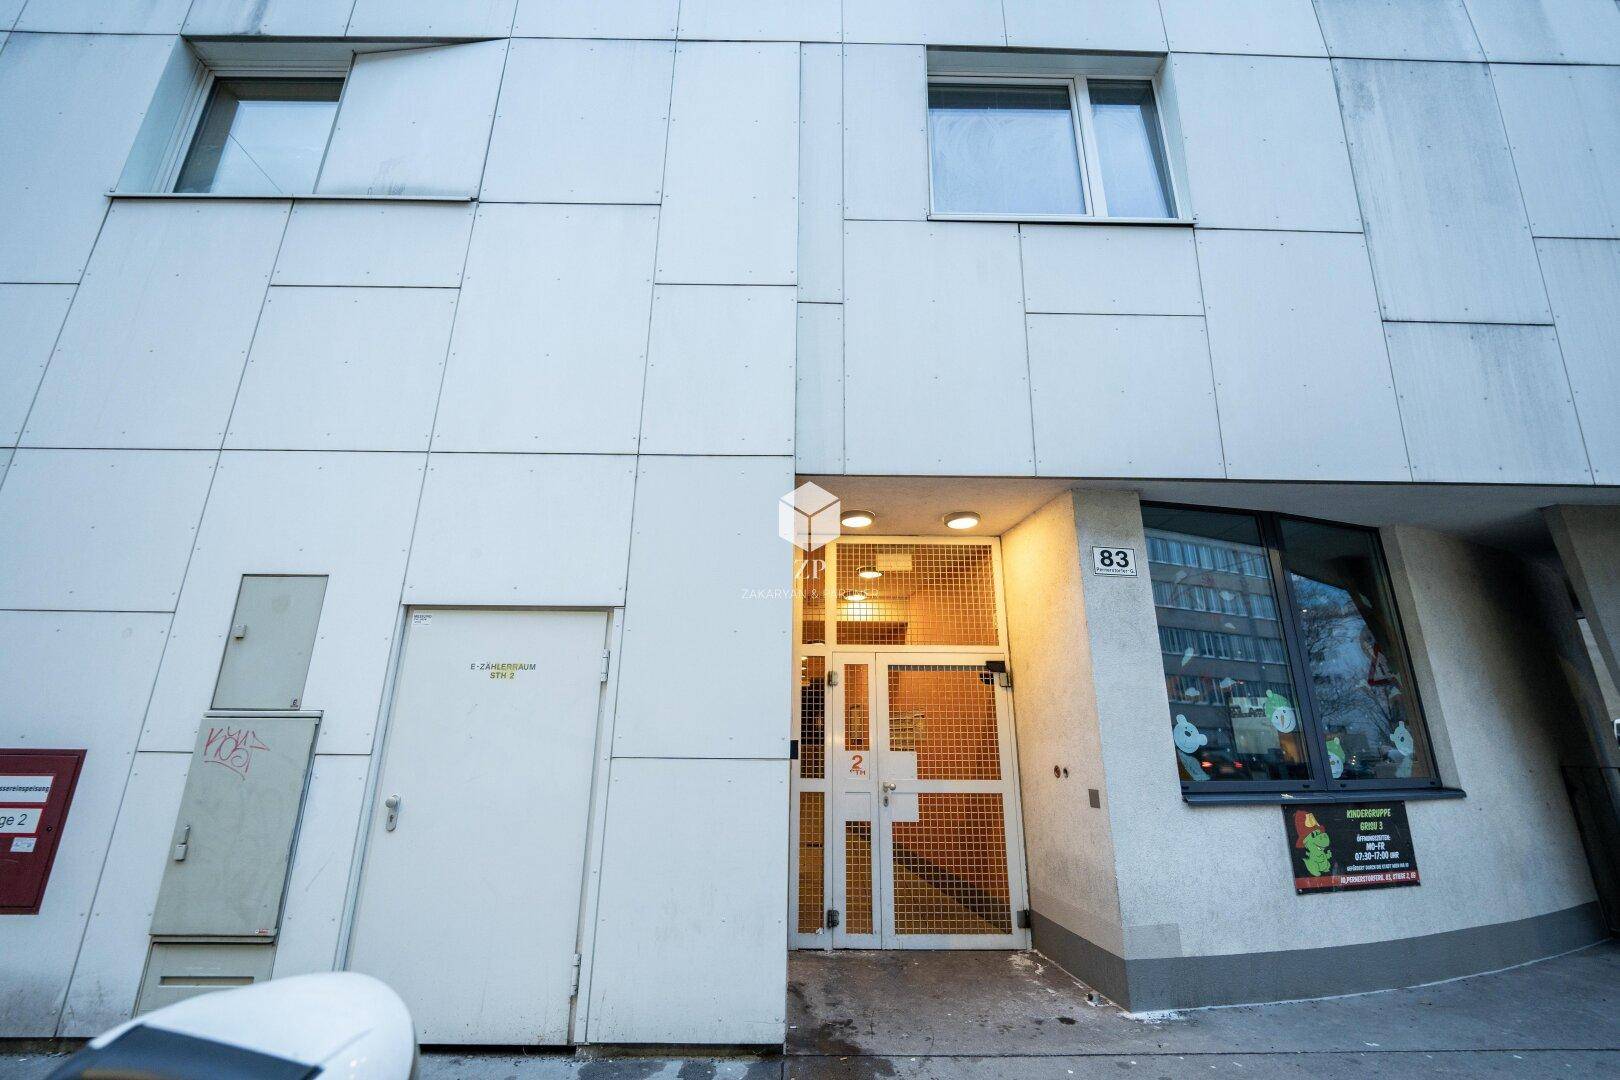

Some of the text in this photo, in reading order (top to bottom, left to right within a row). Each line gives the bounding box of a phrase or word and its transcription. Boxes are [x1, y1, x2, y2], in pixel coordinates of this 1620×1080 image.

[1100, 550, 1129, 567] 83
[470, 661, 536, 671] E-ZÄHLERRAUM
[852, 755, 863, 770] 2
[1346, 809, 1391, 818] KINDERGRUPPE
[18, 813, 28, 826] 2
[1360, 821, 1384, 831] GRISU 3
[1366, 842, 1385, 851] MO-FR
[1355, 851, 1389, 861] 07:30-17:00
